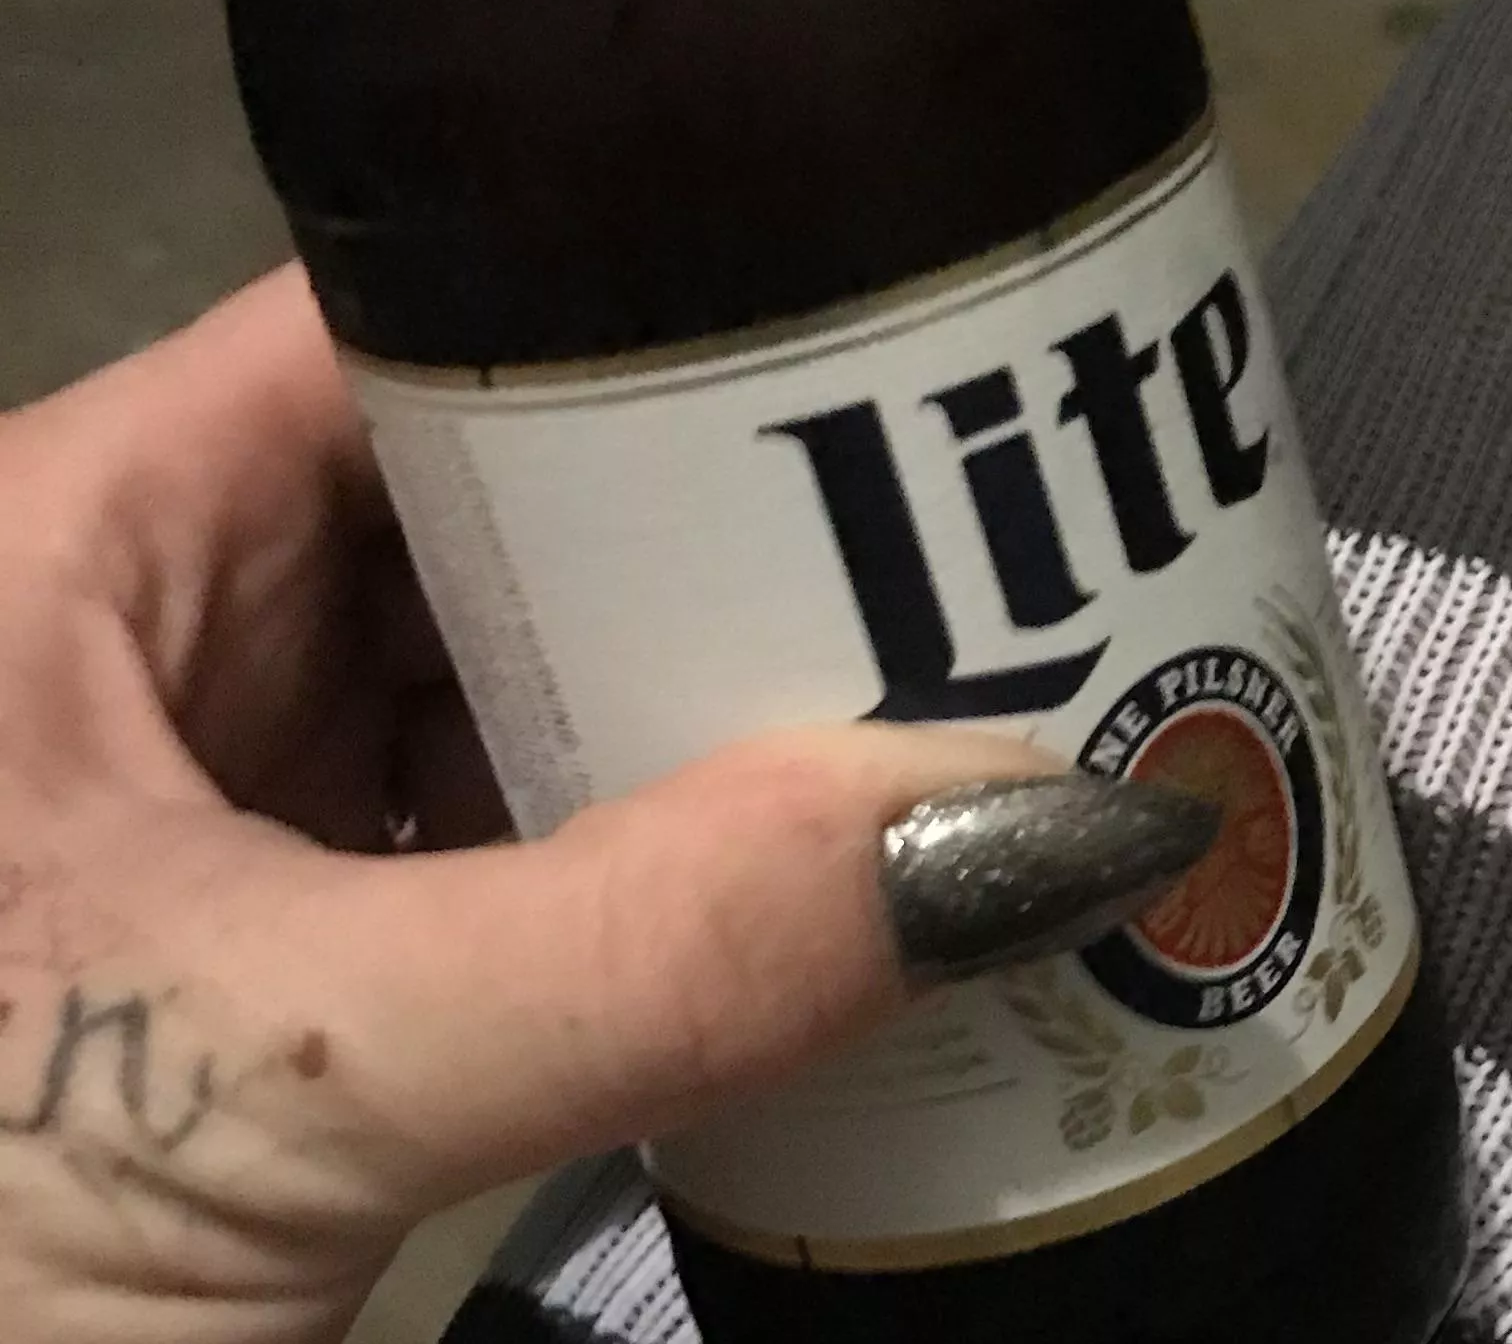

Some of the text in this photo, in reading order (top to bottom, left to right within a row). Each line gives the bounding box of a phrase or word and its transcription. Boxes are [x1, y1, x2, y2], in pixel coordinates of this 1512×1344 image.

[756, 267, 1271, 724] Lite
[1087, 656, 1300, 774] NE PILSNER
[1197, 930, 1304, 1023] BEER
